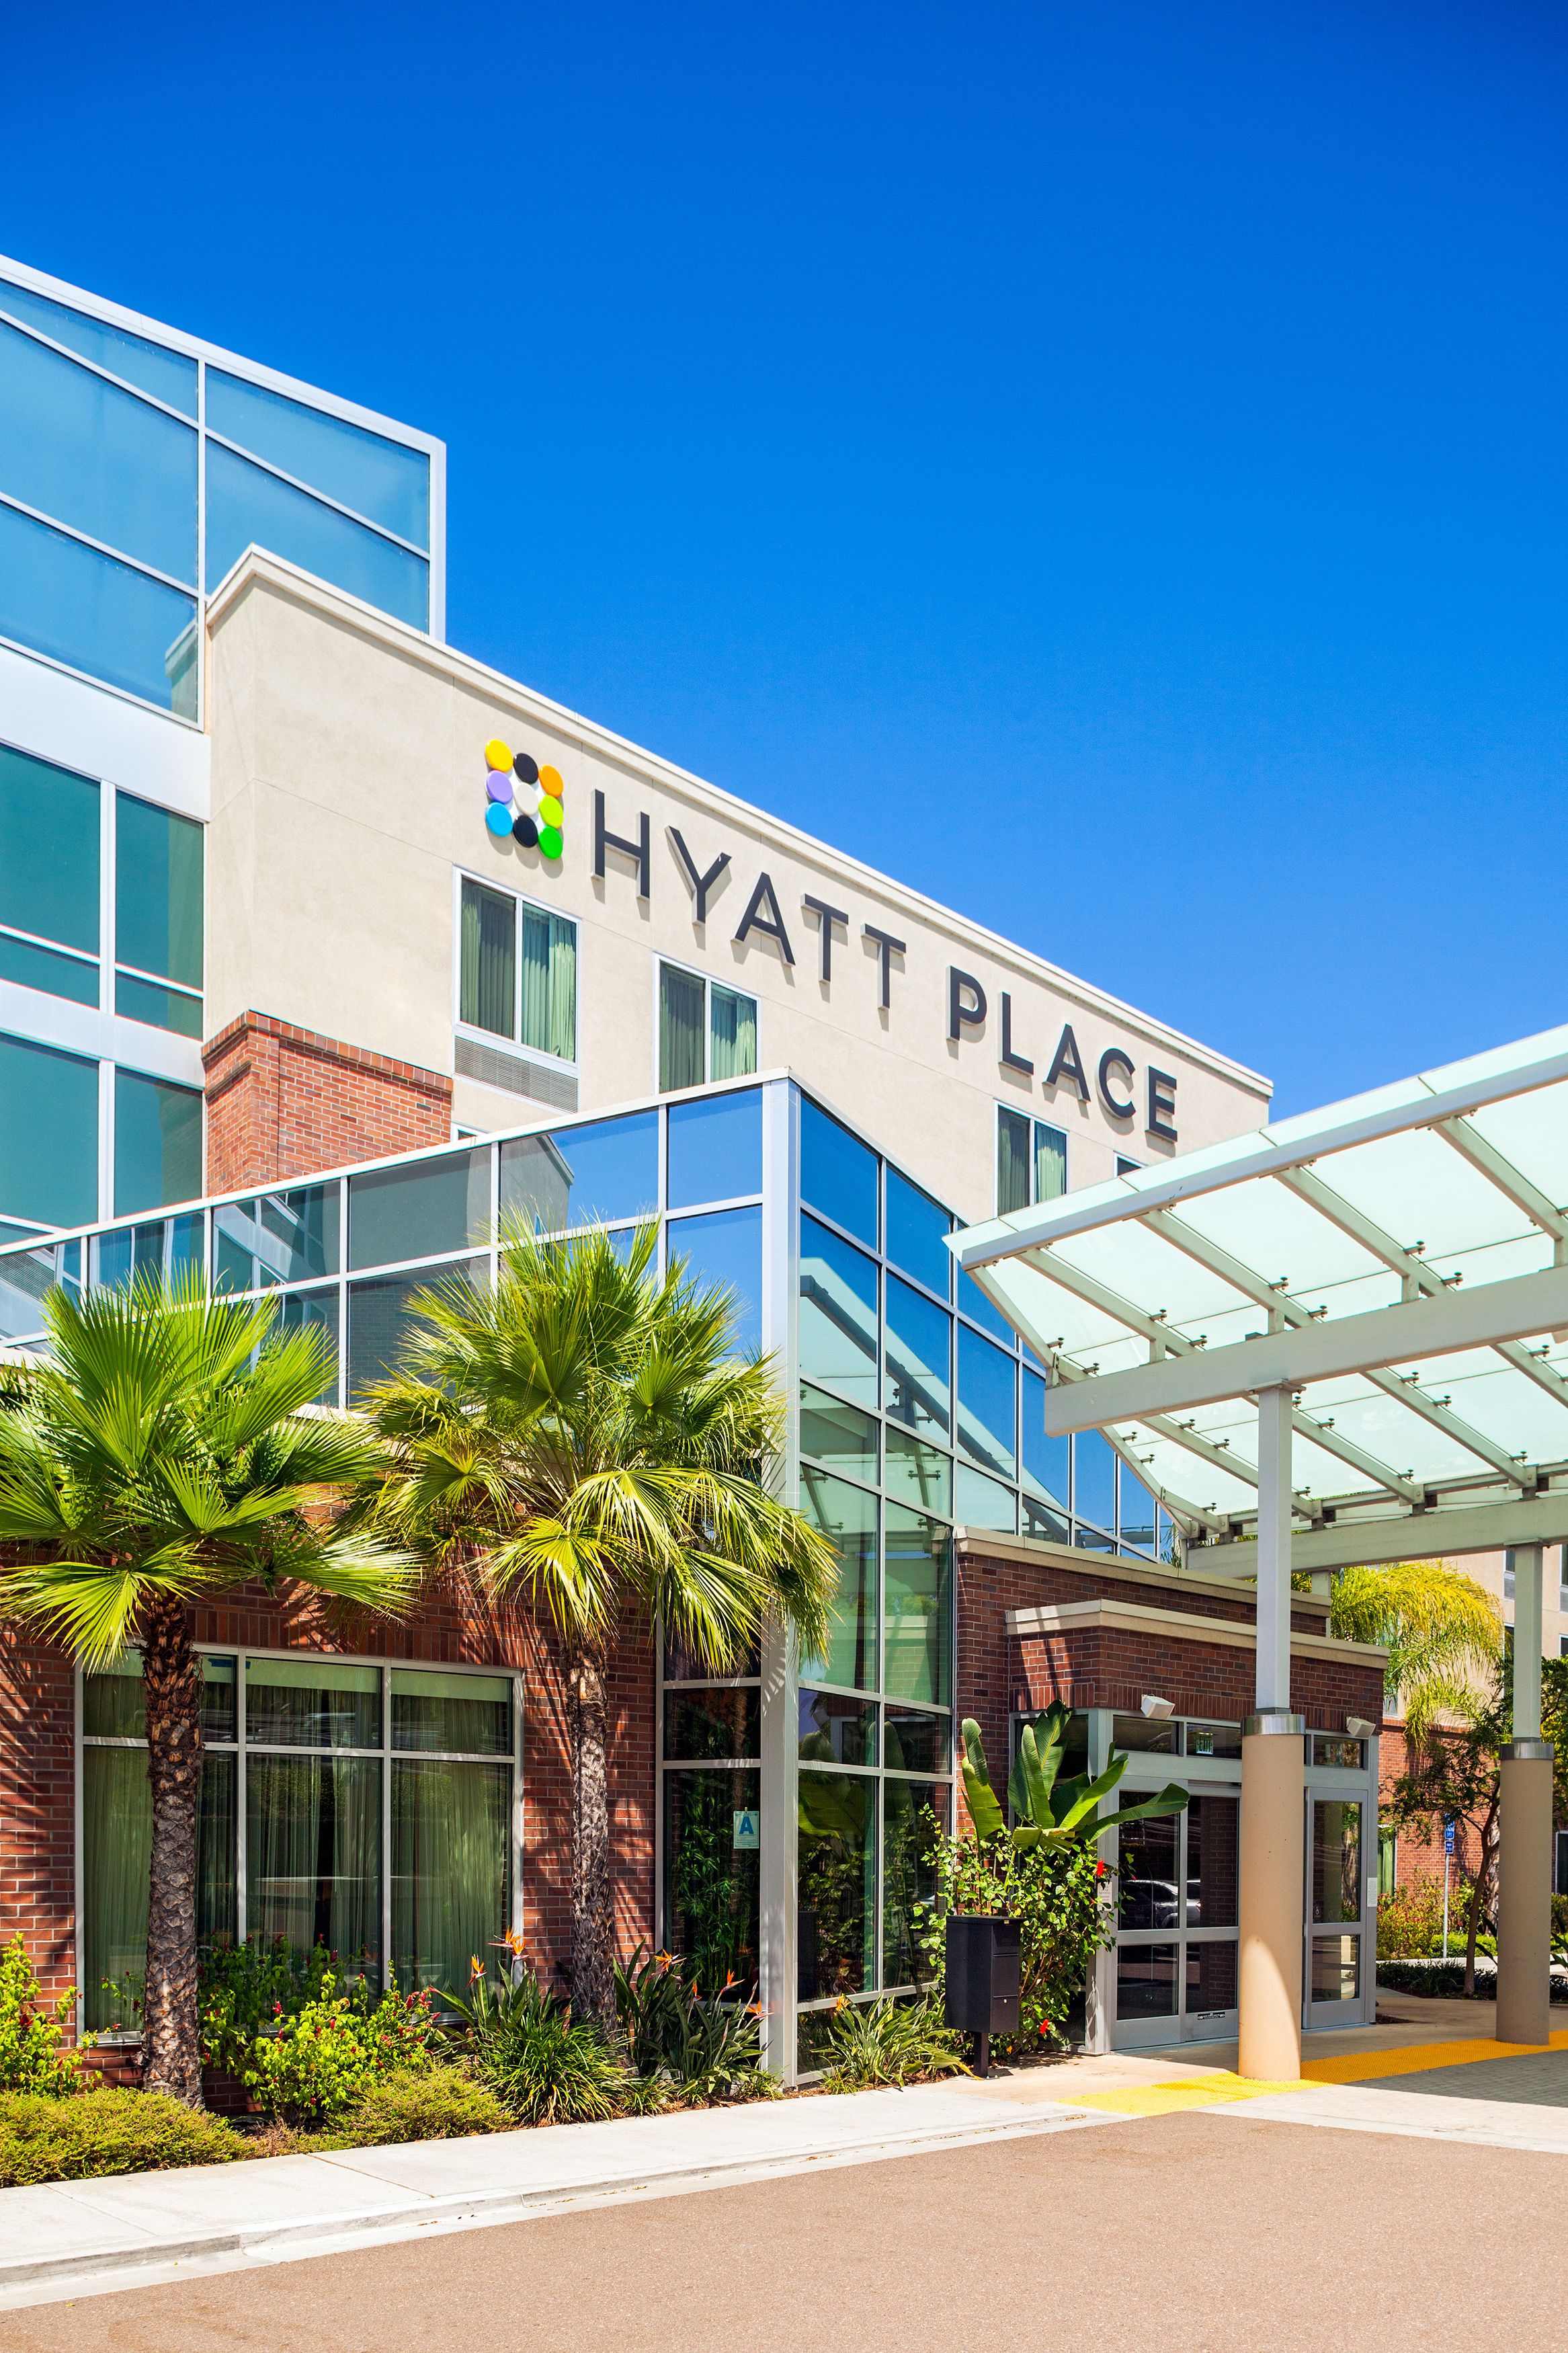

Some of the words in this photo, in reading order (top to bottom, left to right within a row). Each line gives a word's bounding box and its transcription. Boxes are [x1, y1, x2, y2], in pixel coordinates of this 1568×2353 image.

[591, 789, 907, 1010] HYATT
[946, 965, 1178, 1143] PLACE
[739, 1816, 754, 1835] A
